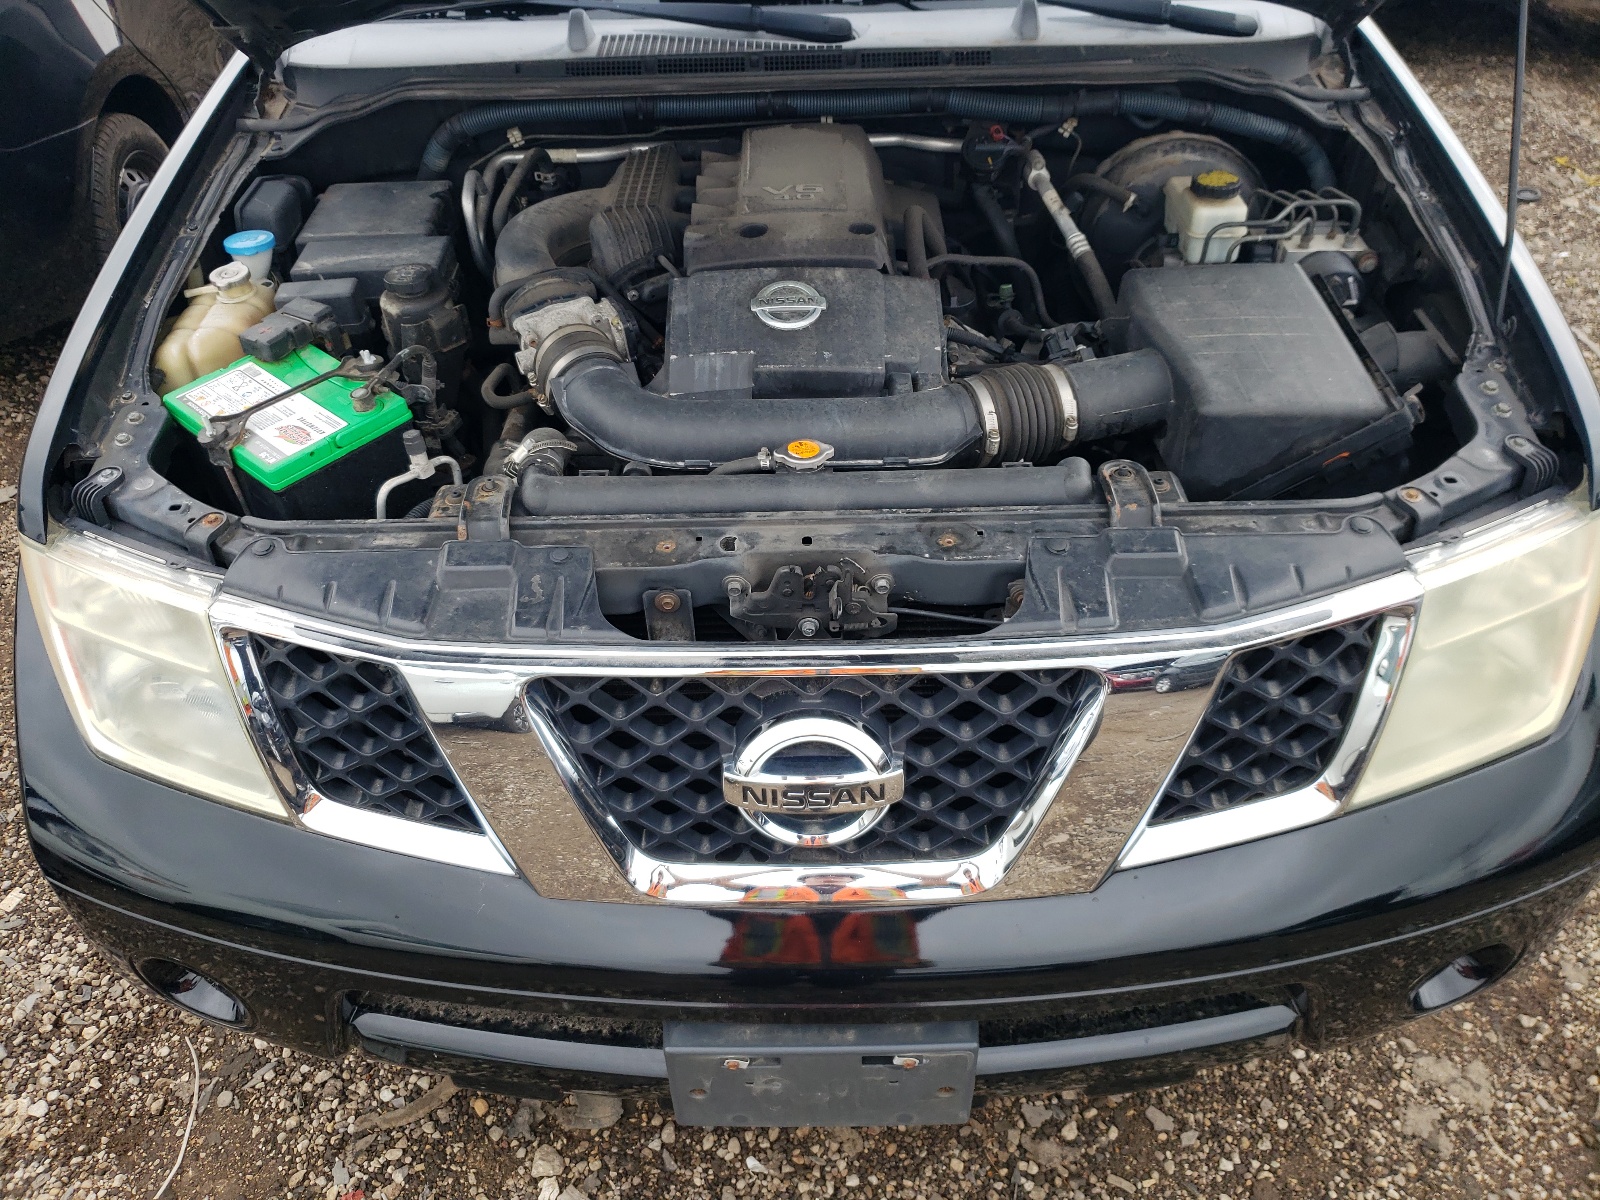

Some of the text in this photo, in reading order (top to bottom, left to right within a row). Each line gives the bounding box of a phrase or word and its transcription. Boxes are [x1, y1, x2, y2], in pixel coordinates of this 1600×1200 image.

[761, 184, 824, 195] V6
[758, 296, 819, 305] NISSAN
[742, 783, 886, 810] NISSAN
